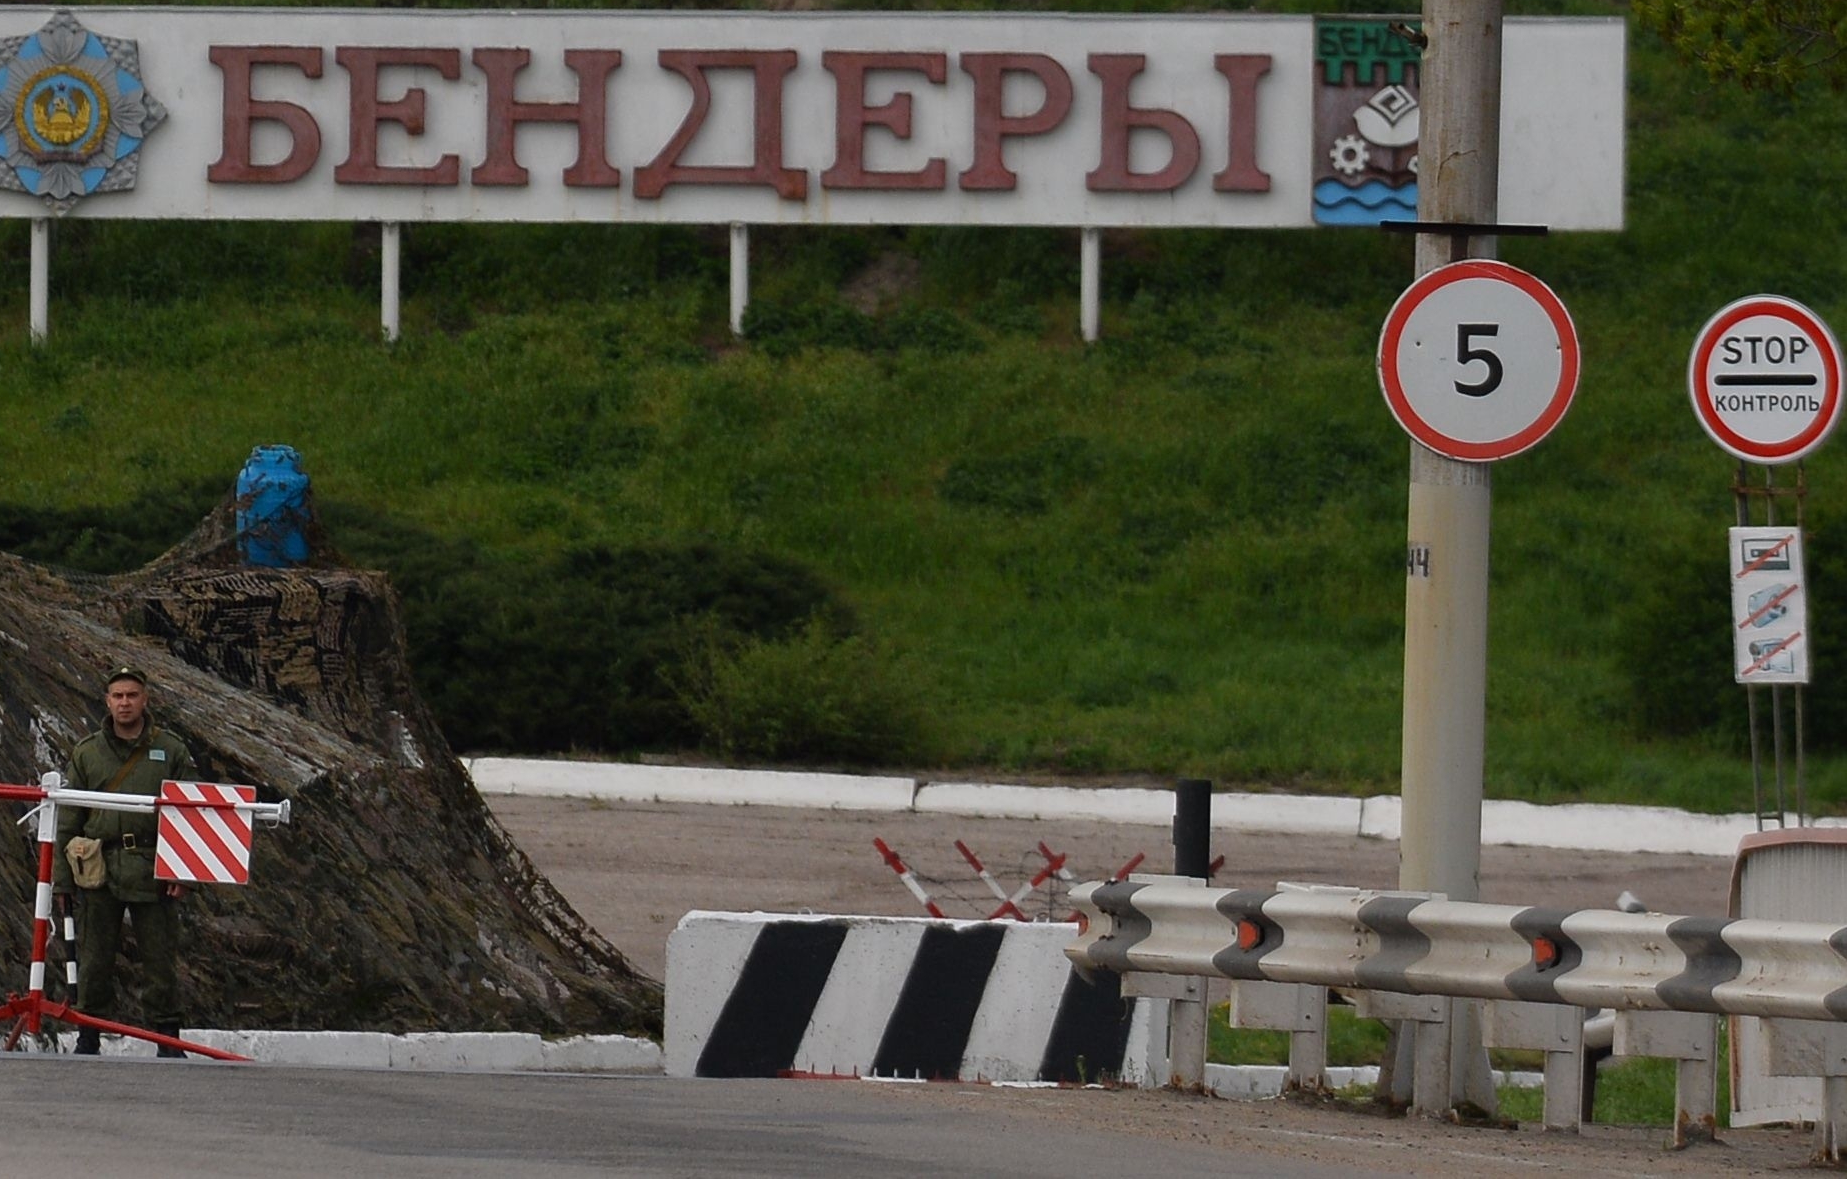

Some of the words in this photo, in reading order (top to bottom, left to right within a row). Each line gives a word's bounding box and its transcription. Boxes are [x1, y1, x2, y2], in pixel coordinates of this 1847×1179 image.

[1318, 26, 1420, 57] БЕНД
[208, 44, 1272, 199] БЕНДЕРЫ
[1454, 323, 1504, 397] 5
[1721, 336, 1809, 364] STOP
[1715, 395, 1820, 412] КОНТРОЛЬ
